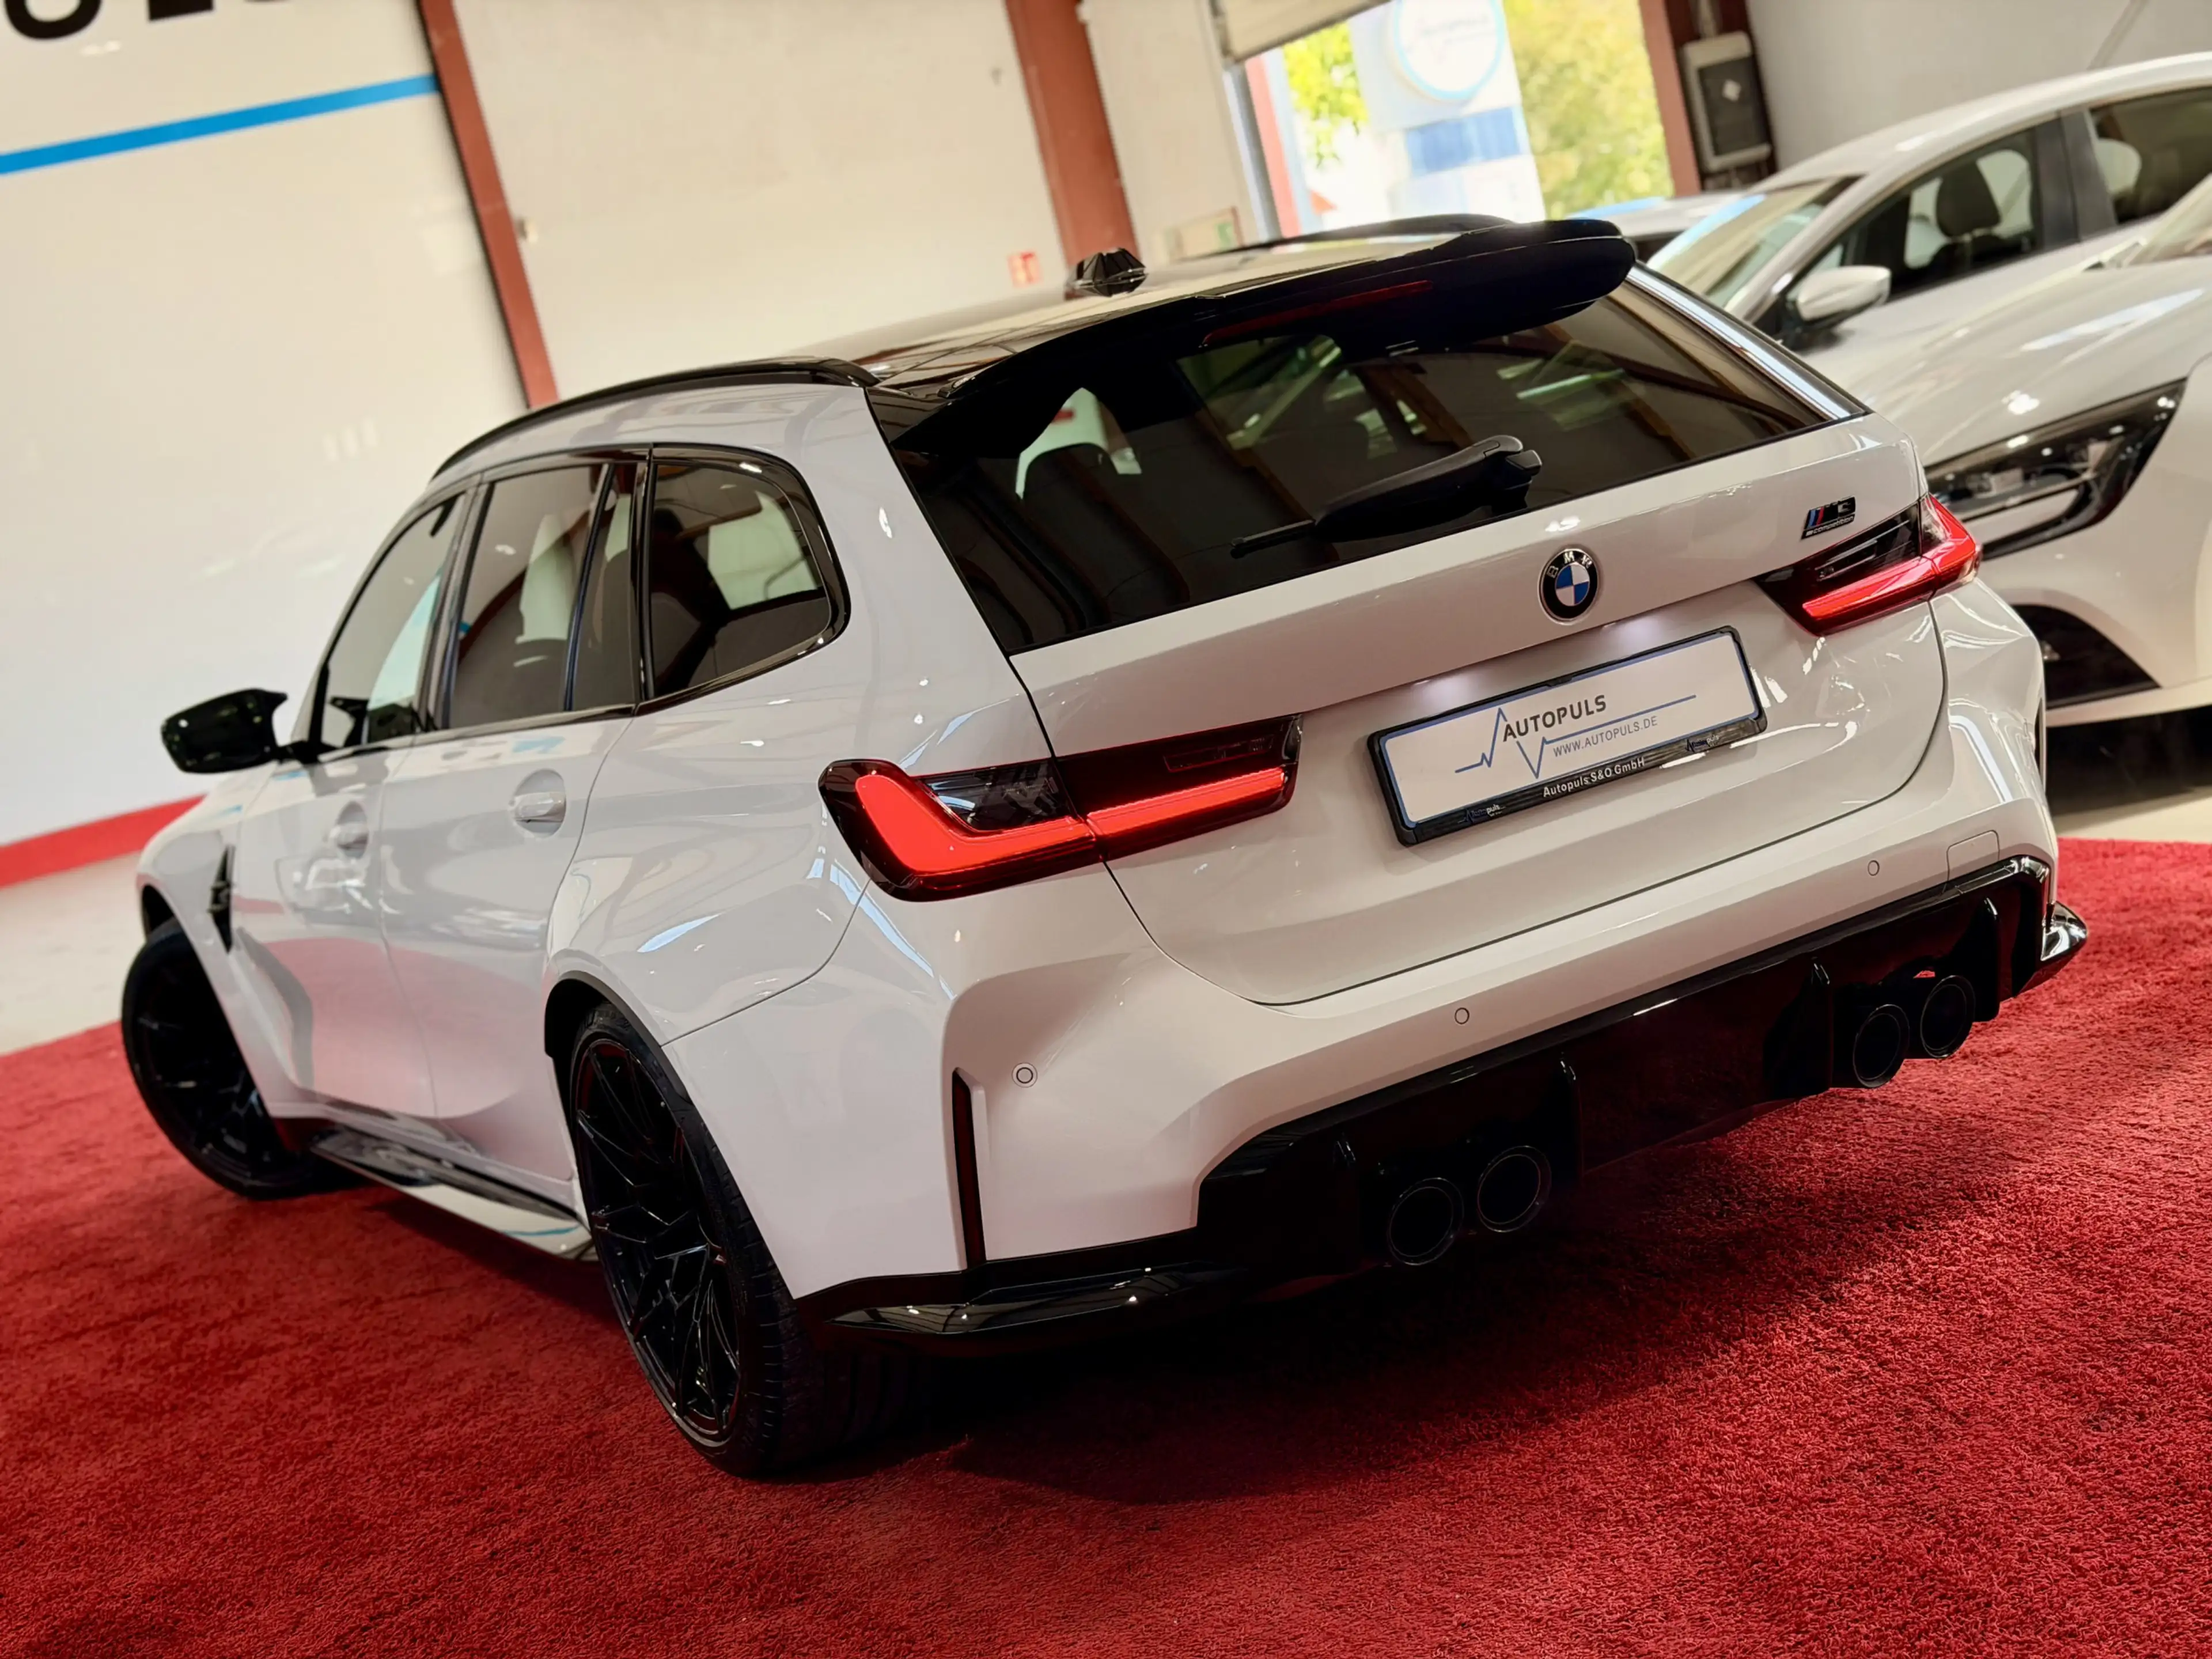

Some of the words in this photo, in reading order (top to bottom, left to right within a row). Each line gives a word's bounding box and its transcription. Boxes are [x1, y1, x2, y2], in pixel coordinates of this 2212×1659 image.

[1546, 550, 1593, 578] BMW
[1502, 694, 1607, 742] AUTOPULS
[1552, 715, 1658, 757] WWW.AUTOPULS.DE
[1543, 776, 1589, 797] Autopuls
[1590, 767, 1612, 783] S&O
[1614, 757, 1645, 775] GmbH
